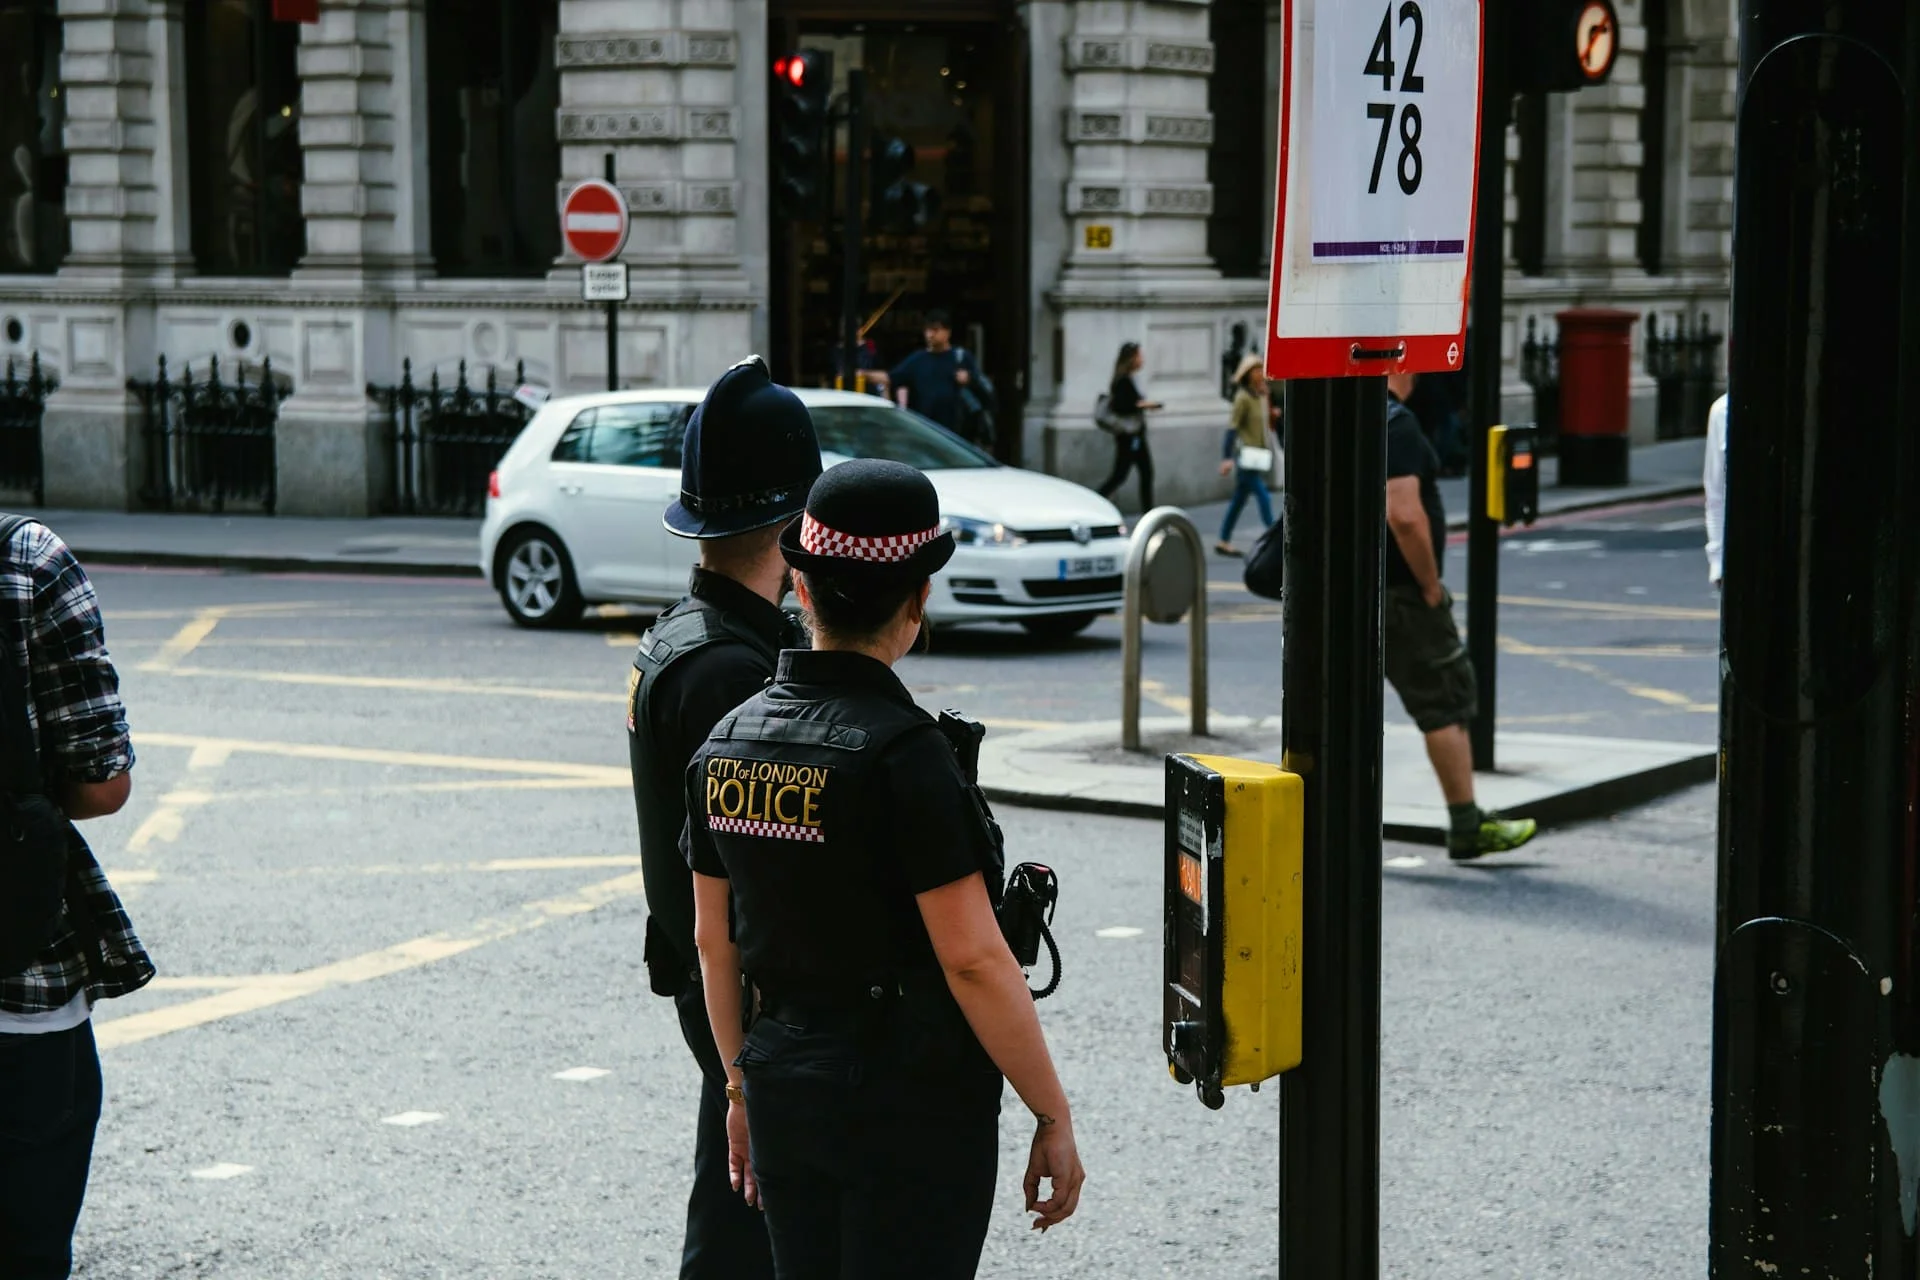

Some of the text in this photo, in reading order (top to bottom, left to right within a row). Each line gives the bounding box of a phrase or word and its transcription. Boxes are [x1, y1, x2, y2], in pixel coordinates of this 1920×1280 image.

[1363, 0, 1424, 93] 42
[1367, 103, 1422, 195] 78
[707, 757, 828, 788] CITY OF LONDON
[707, 776, 822, 827] POLICE
